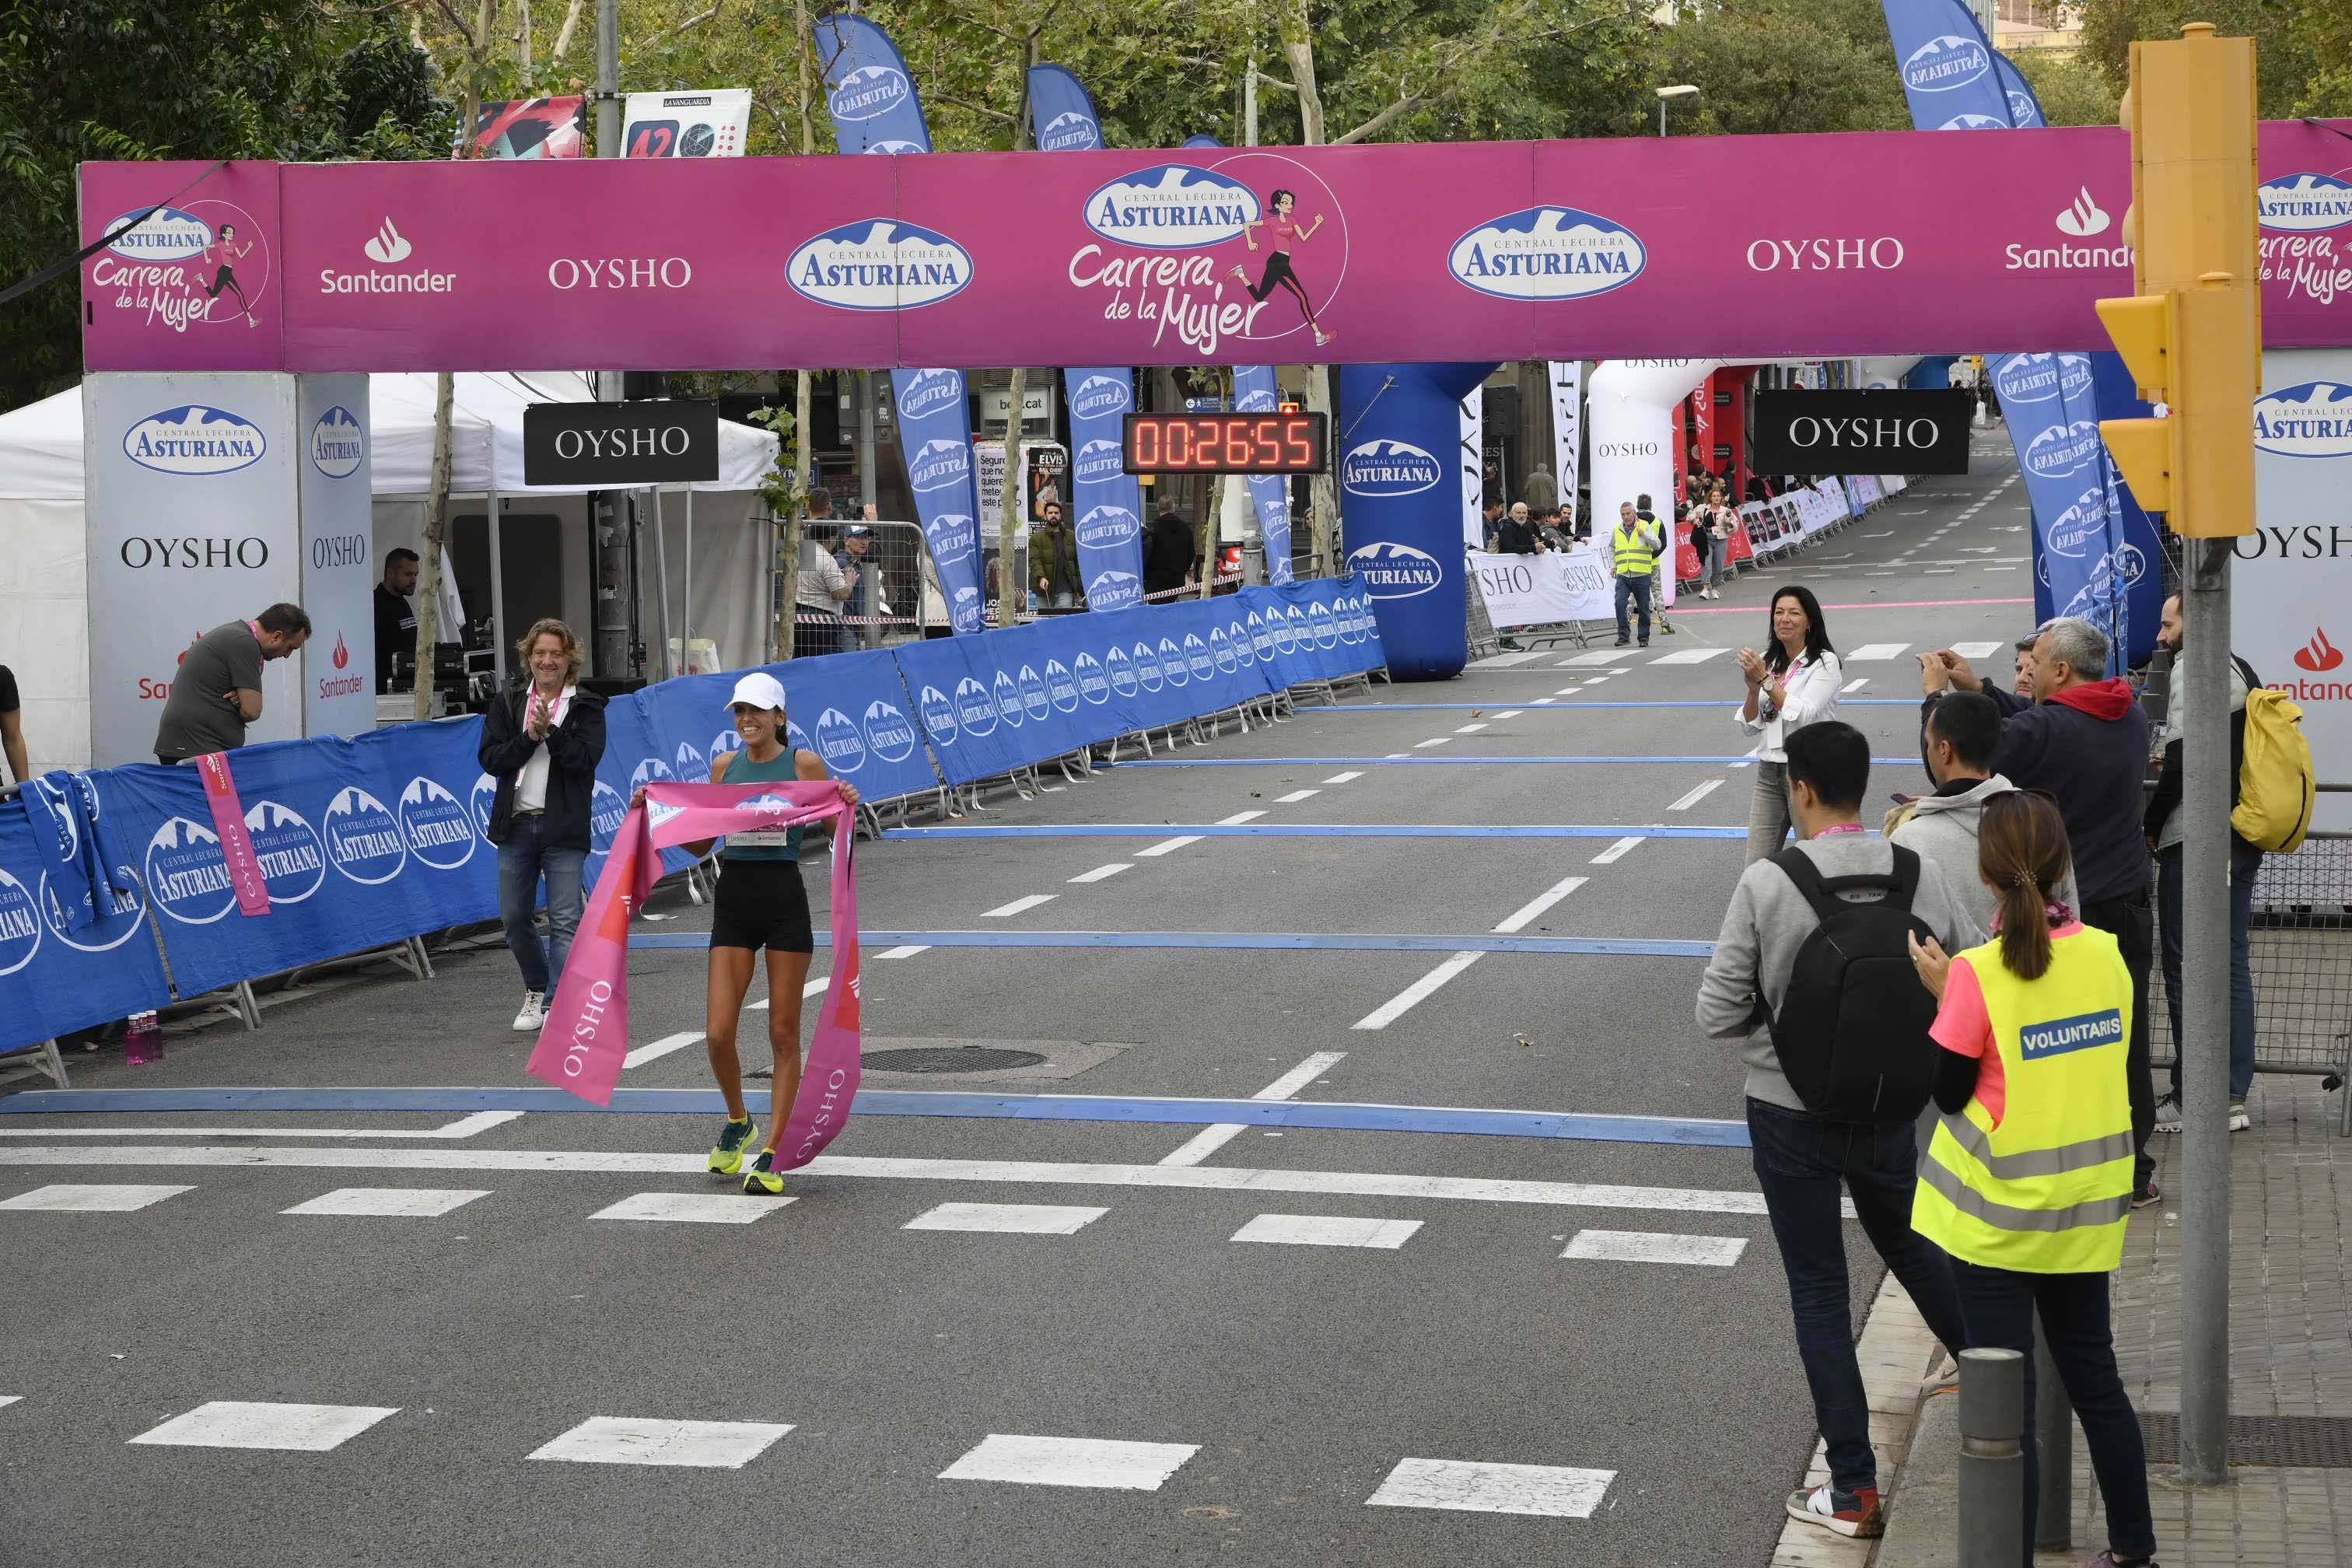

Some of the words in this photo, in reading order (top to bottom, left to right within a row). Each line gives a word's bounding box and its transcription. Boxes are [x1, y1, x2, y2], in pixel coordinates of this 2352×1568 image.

[630, 128, 672, 157] 42
[1097, 195, 1246, 228] ASTURIANA
[1124, 193, 1183, 202] CENTRAL
[1186, 191, 1242, 201] LECHERA
[111, 226, 205, 248] ASTURIANA
[133, 223, 165, 232] ENTRAL
[1493, 239, 1555, 249] CENTRAL
[1562, 237, 1625, 247] LECHERA
[828, 250, 889, 260] CENTRAL
[893, 249, 953, 259] LECHERA
[1463, 243, 1632, 278] ASTURIANA
[1747, 236, 1905, 271] OYSHO
[2005, 243, 2134, 269] Santand
[2259, 236, 2333, 258] arrera
[93, 257, 184, 287] Carrera
[320, 269, 457, 294] Santander
[548, 257, 691, 290] OYSHO
[800, 254, 959, 288] ASTURIANA
[1069, 243, 1213, 289] Carrera
[2277, 259, 2291, 281] la
[2287, 254, 2352, 305] Muje
[115, 288, 133, 309] de
[137, 288, 149, 309] la
[146, 285, 219, 333] Mujer
[1104, 289, 1132, 320] de
[1137, 288, 1157, 320] la
[1153, 282, 1269, 355] Mujer
[2274, 408, 2327, 417] CENTRAL
[135, 431, 256, 457] ASTURIANA
[205, 429, 251, 437] LECHERA
[315, 433, 361, 461] ASTURIANA
[555, 426, 690, 460] OYSHO
[1136, 422, 1310, 465] 00:26:55
[1789, 417, 1940, 450] OYSHO
[1039, 455, 1063, 464] ELVIS
[1598, 443, 1657, 457] OYSHO
[1346, 463, 1433, 484] ASTURIANA
[121, 537, 268, 569] OYSHO
[313, 534, 365, 569] OYSHO
[2232, 525, 2352, 559] OYSH
[1482, 565, 1532, 597] SHO
[320, 675, 363, 699] Santander
[821, 735, 863, 759] ASTURIANA
[338, 820, 366, 832] CENTRAL
[411, 808, 435, 821] CENTRAL
[436, 805, 459, 816] LECHERA
[331, 826, 402, 863] ASTURIANA
[406, 814, 471, 849] ASTURIANA
[163, 854, 194, 868] CENTRAL
[229, 824, 256, 898] OYSHO
[256, 844, 322, 880] STURIANA
[155, 862, 233, 903] ASTURIANA
[564, 980, 612, 1077] OYSHO
[2022, 1017, 2121, 1052] VOLUNTARIS
[796, 1069, 845, 1160] OYSHO
